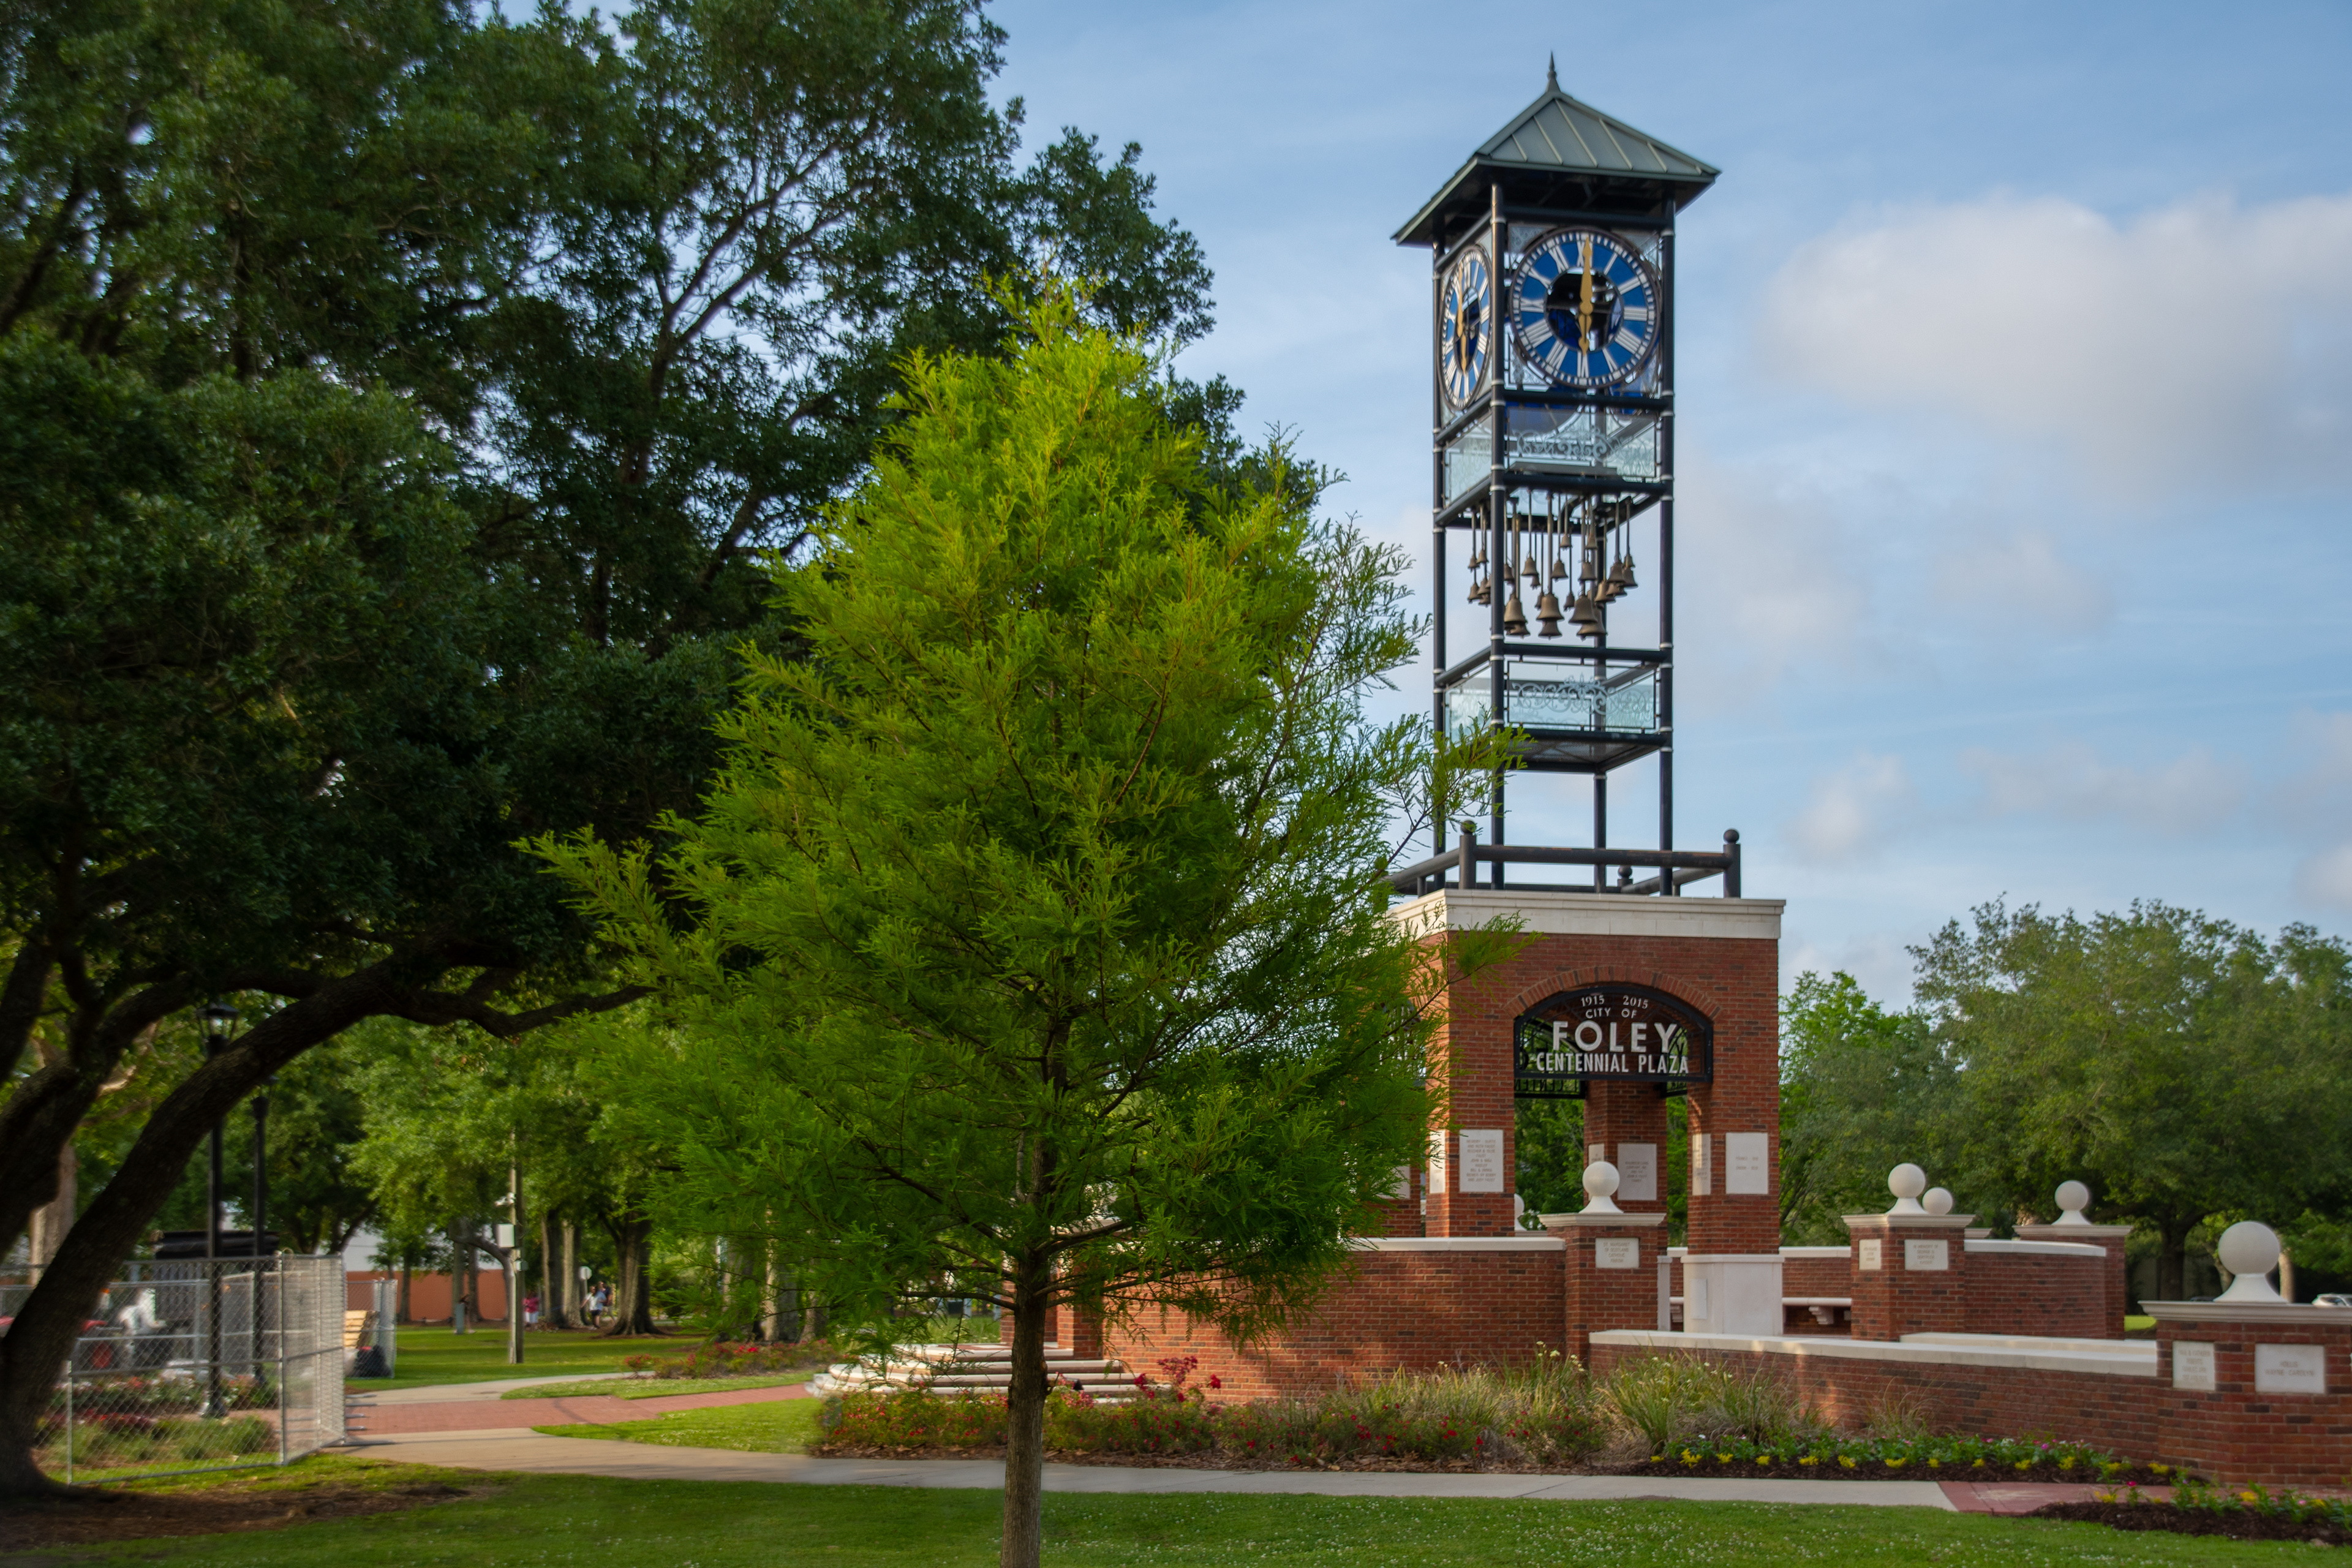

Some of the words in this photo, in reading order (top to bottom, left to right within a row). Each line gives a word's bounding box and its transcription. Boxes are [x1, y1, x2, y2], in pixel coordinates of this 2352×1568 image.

[1548, 244, 1569, 274] XI
[1577, 241, 1593, 268] XI
[1528, 267, 1551, 289] X
[1618, 276, 1640, 295] II
[1520, 297, 1544, 313] IX
[1624, 306, 1648, 321] III
[1615, 326, 1642, 355] IIII
[1546, 341, 1568, 370] VII
[1581, 995, 1605, 1007] 1915
[1623, 995, 1649, 1009] 2015
[1585, 1008, 1611, 1019] CITY
[1621, 1008, 1637, 1019] OF
[1553, 1020, 1677, 1053] FOLEY
[1536, 1052, 1629, 1072] CENTENNIAL
[1638, 1054, 1689, 1073] PLAZA
